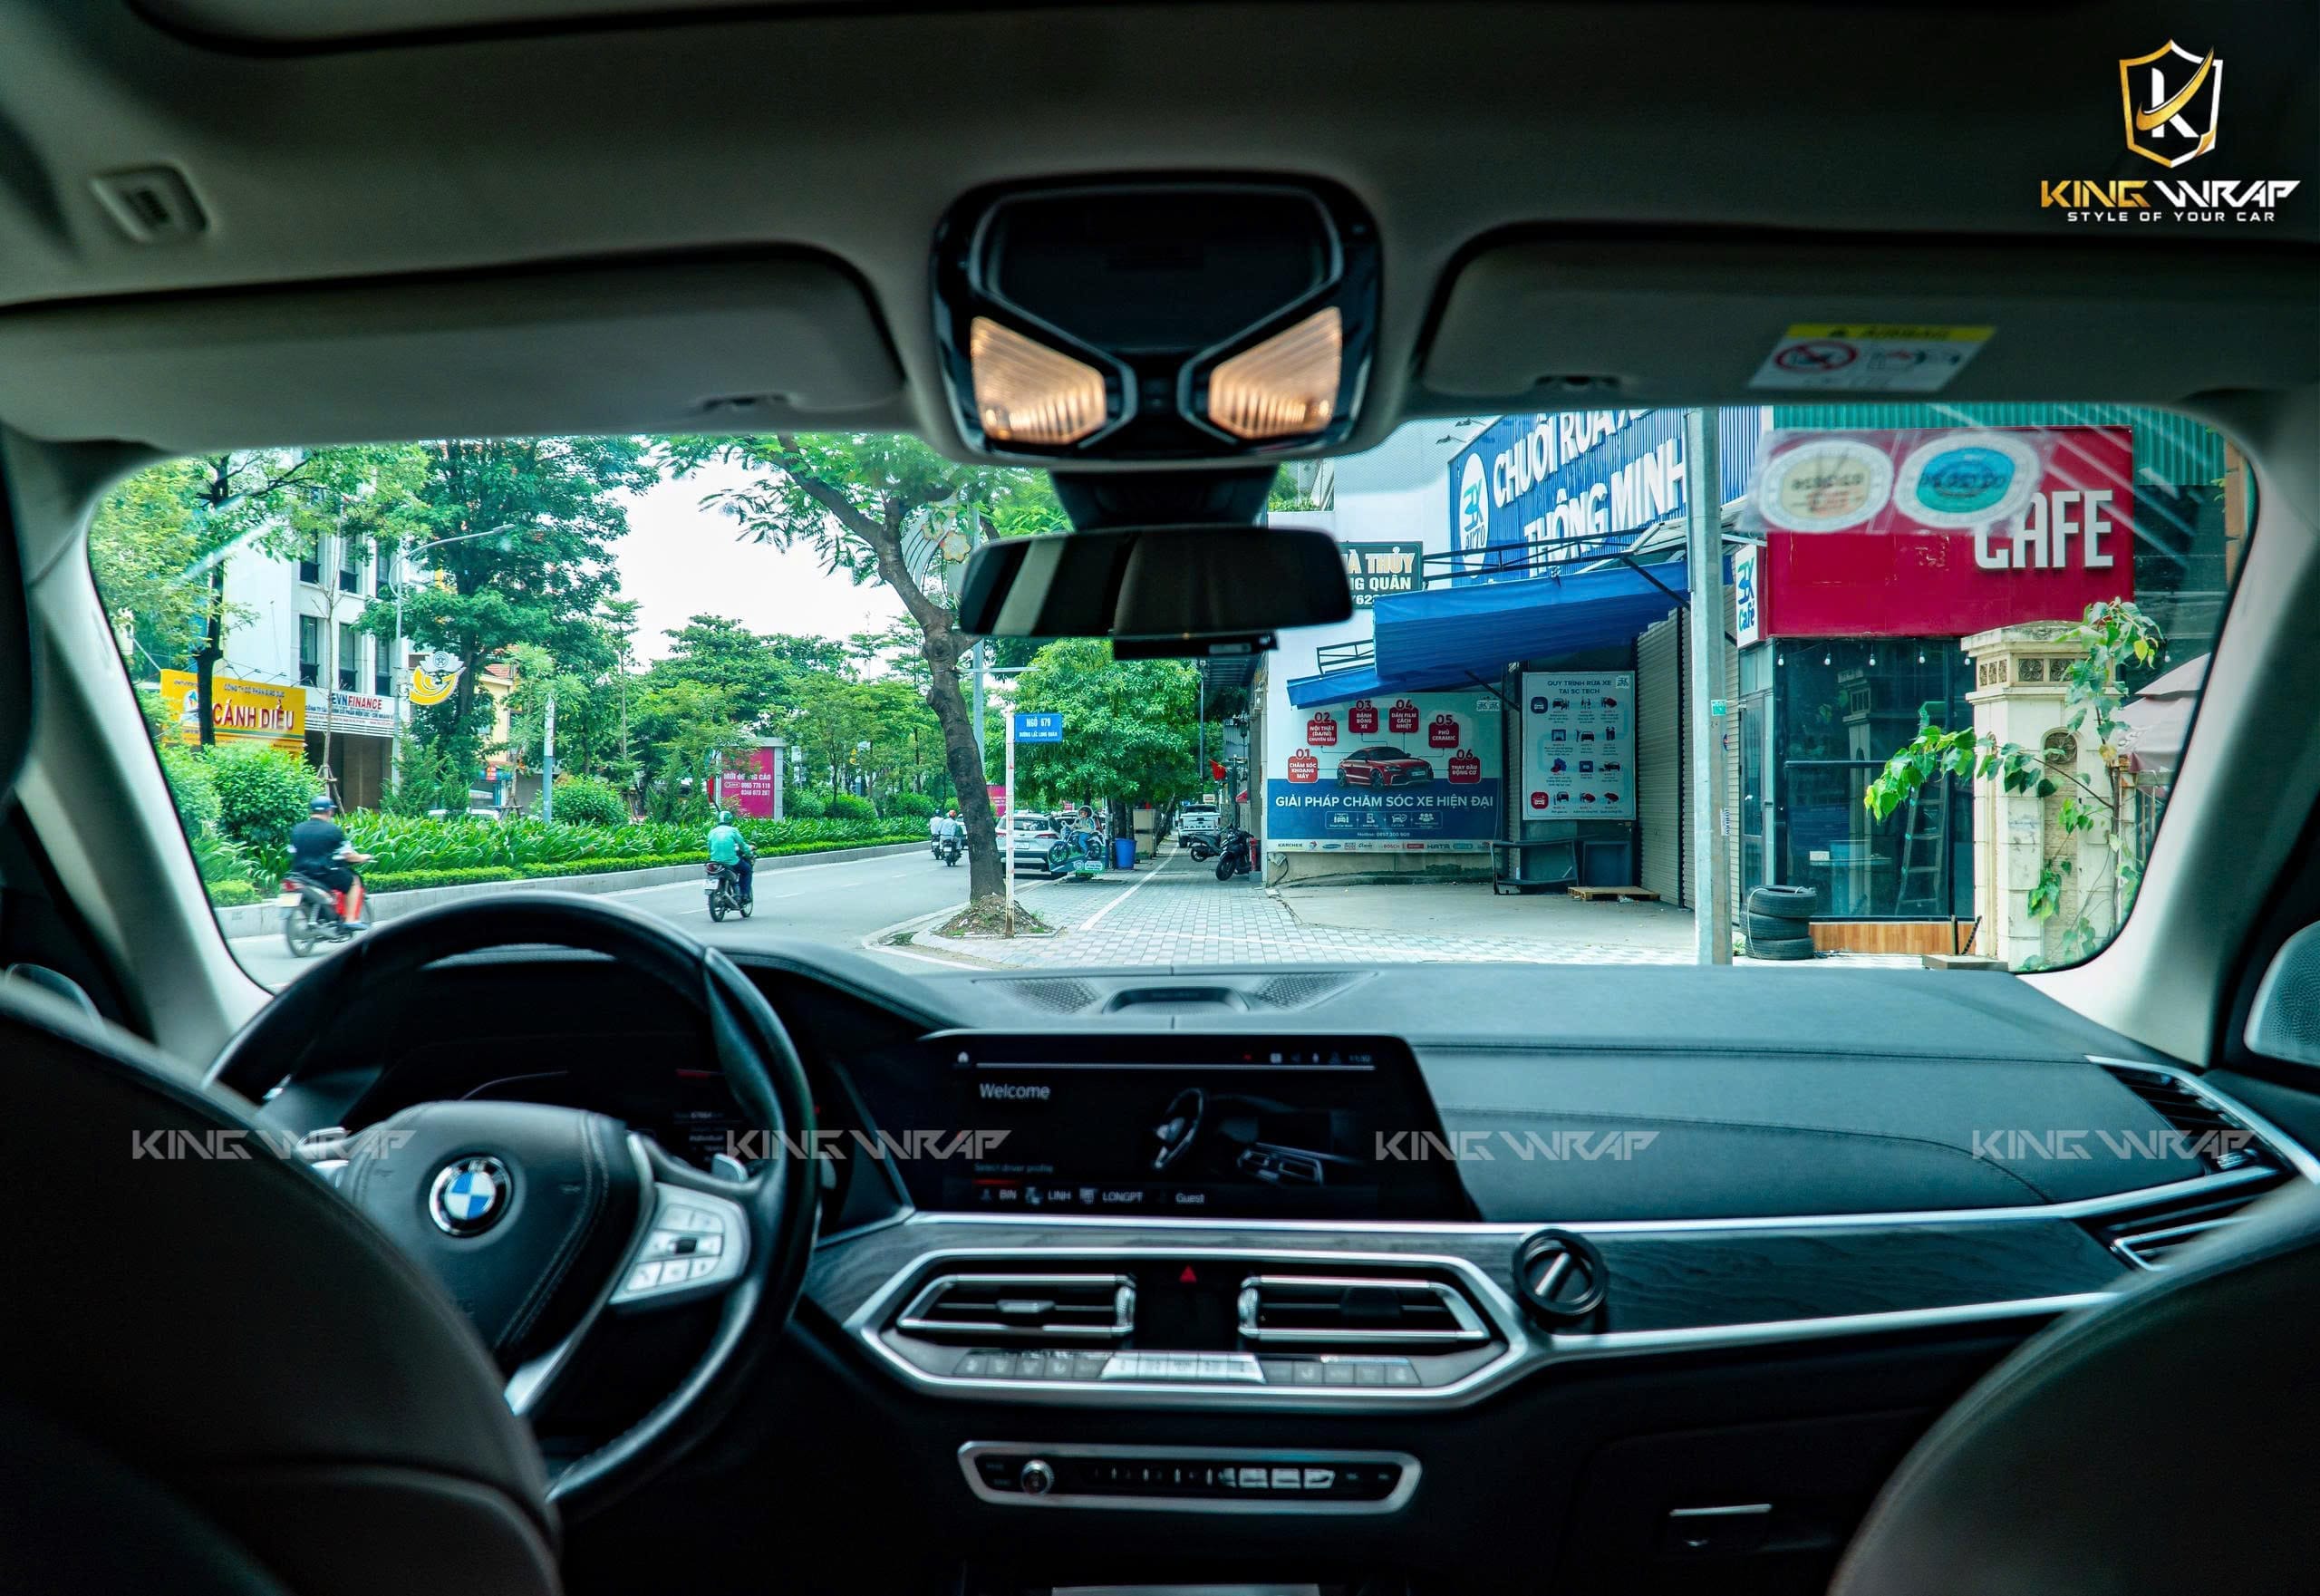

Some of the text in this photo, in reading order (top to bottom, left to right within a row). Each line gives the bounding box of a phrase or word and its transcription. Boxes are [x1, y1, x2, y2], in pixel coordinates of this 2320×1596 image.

[1524, 430, 1687, 577] THÔNG MINH
[1365, 546, 1416, 574] THỦY
[1369, 574, 1412, 591] QUÂN
[331, 692, 382, 711] EVNFINANCE
[1356, 700, 1373, 711] 03
[1396, 699, 1415, 711] 04
[212, 699, 295, 730] CÁNH DIỀU
[1314, 711, 1331, 722] 02
[1436, 714, 1453, 725] 05
[1296, 749, 1310, 759] 01
[1456, 750, 1474, 759] 06
[1275, 793, 1494, 809] GIẢI PHÁP CHĂM SÓC XE HIỆN ĐẠI
[980, 1083, 1050, 1100] Welcome
[1000, 1190, 1017, 1200] BIN
[1048, 1190, 1071, 1201] LINH
[1175, 1192, 1204, 1204] Guest
